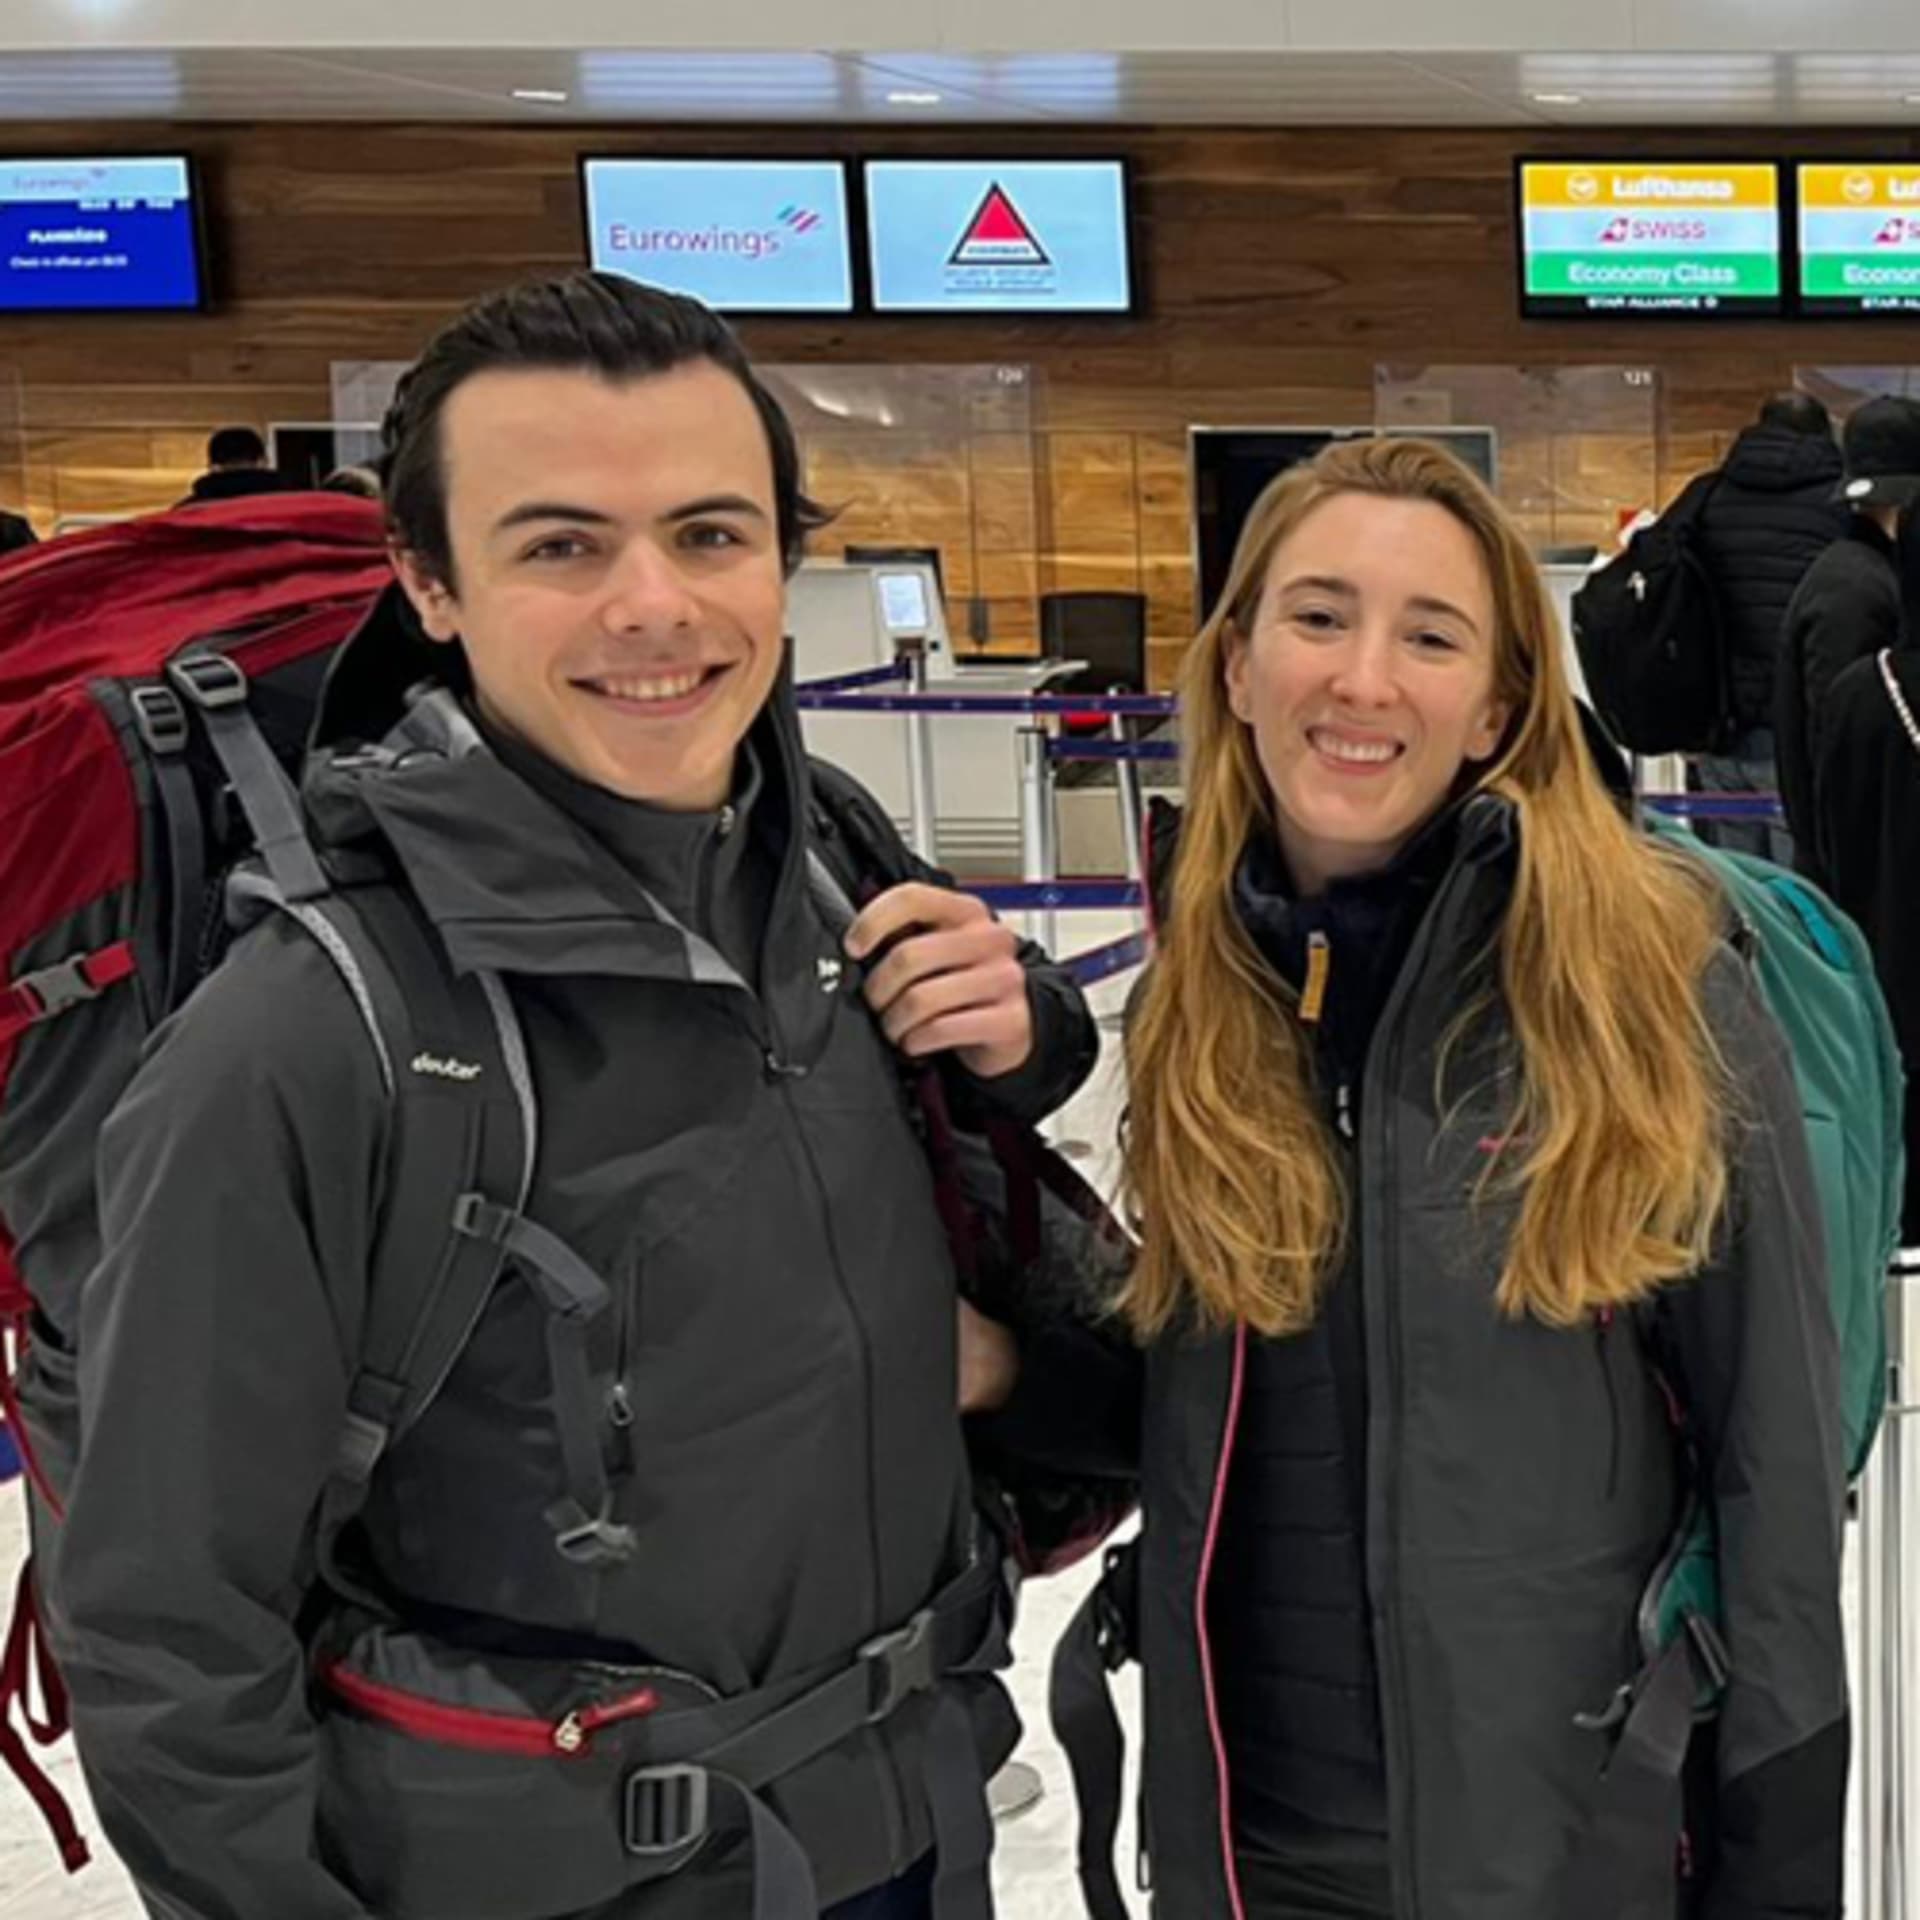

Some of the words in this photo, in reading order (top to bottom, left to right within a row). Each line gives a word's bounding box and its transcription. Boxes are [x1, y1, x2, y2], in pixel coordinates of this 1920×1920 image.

[1612, 175, 1735, 198] Lufthansa
[609, 223, 780, 259] Eurowings
[1632, 222, 1706, 239] SWISS
[1569, 264, 1671, 286] Economy
[1674, 264, 1737, 284] Class
